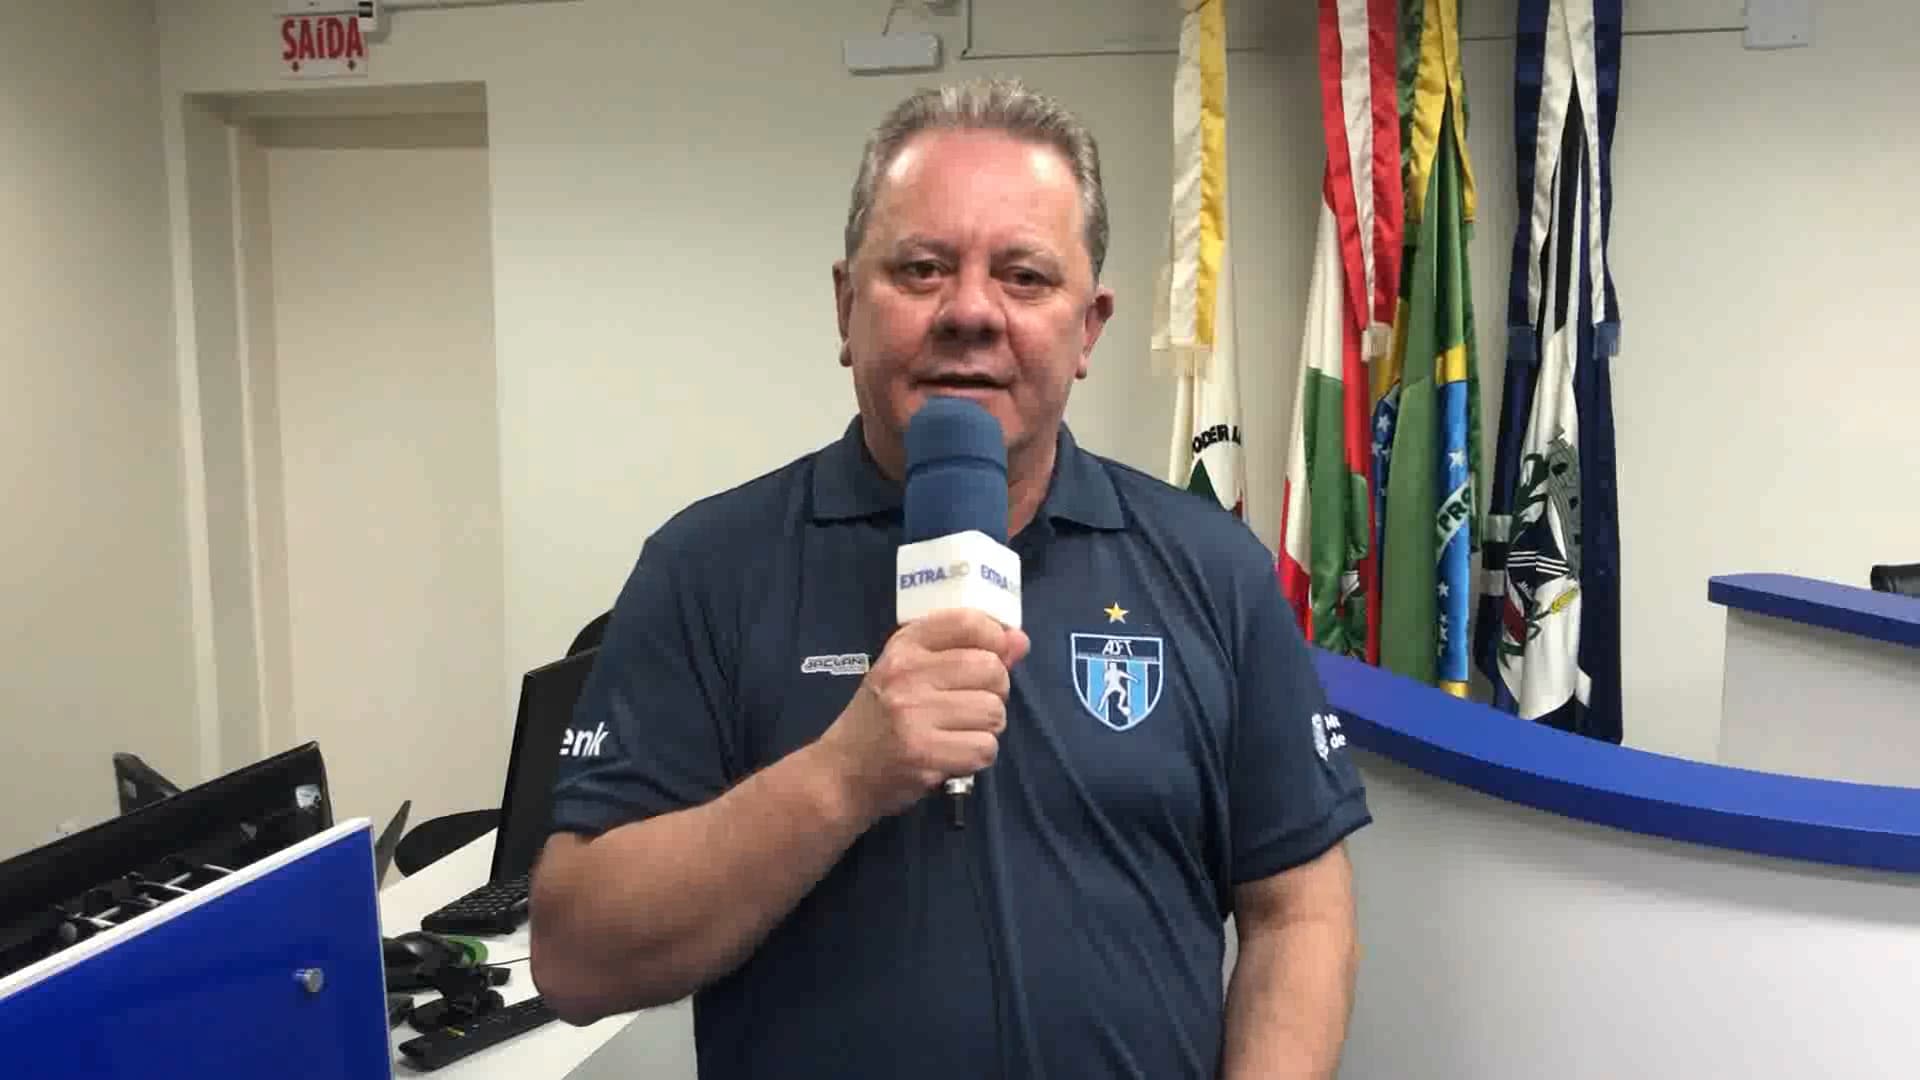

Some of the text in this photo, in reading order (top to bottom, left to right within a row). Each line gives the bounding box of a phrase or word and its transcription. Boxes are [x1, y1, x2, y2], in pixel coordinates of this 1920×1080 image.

[281, 16, 364, 60] SAÍDA
[1191, 424, 1230, 454] ODER
[1329, 731, 1347, 749] de
